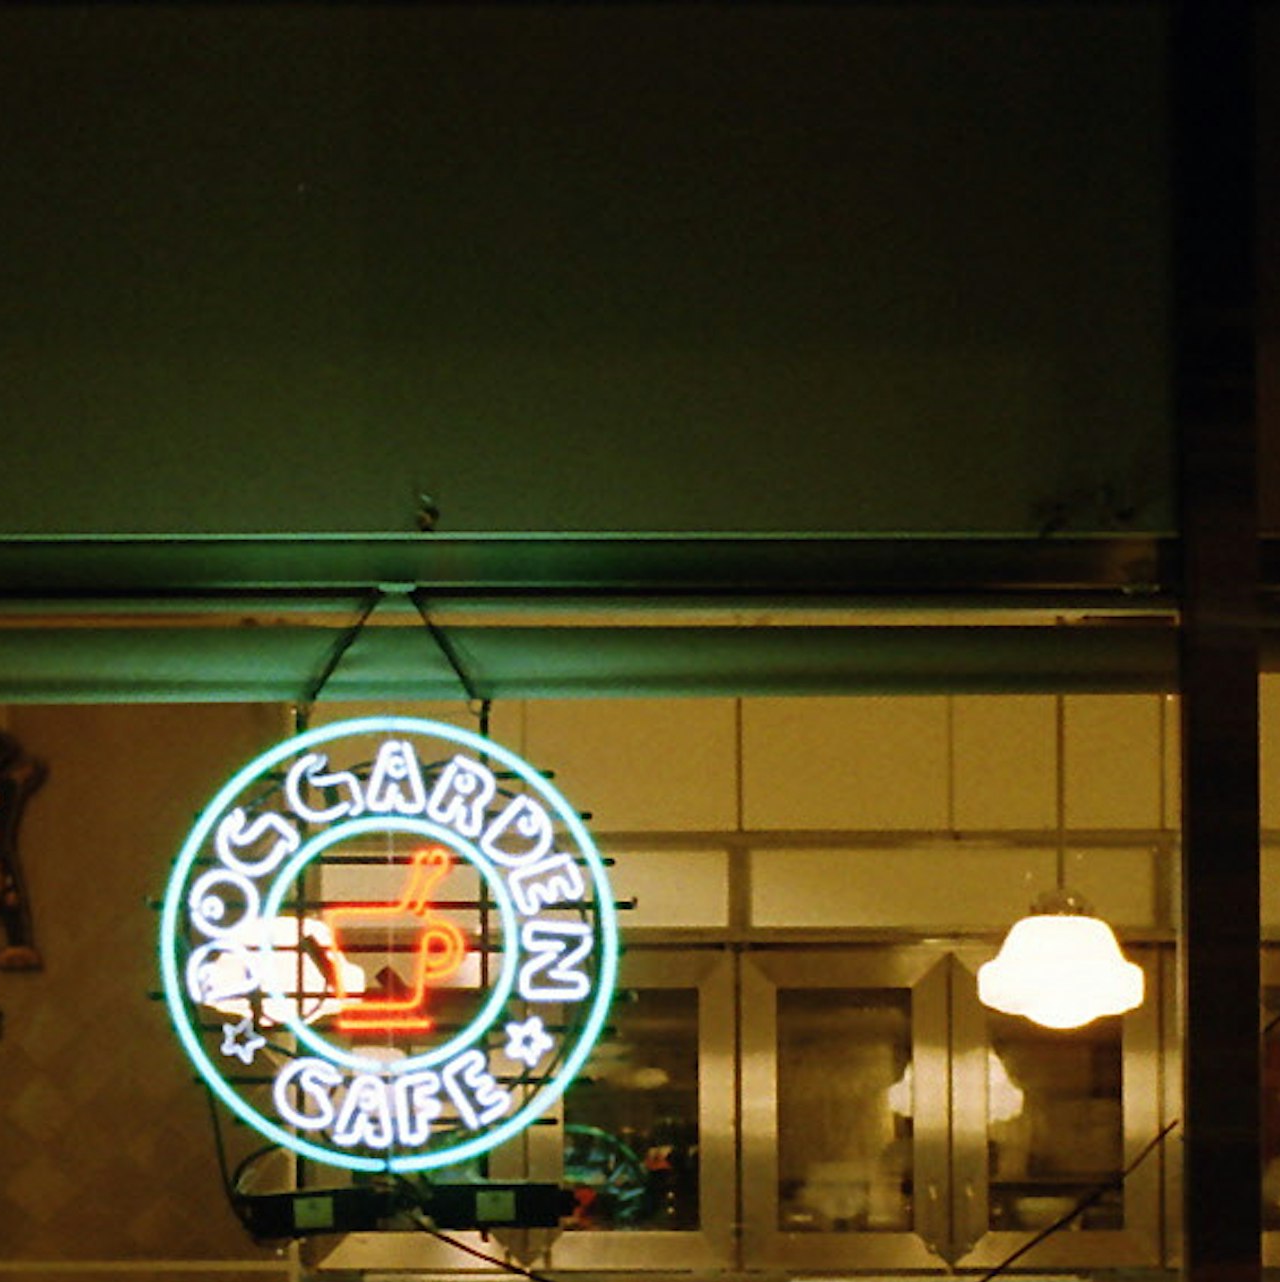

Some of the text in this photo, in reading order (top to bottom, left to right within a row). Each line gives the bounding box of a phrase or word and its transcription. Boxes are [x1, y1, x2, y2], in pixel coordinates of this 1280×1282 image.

[187, 740, 593, 1003] DOG GARDEN
[273, 1049, 513, 1149] CAFE
